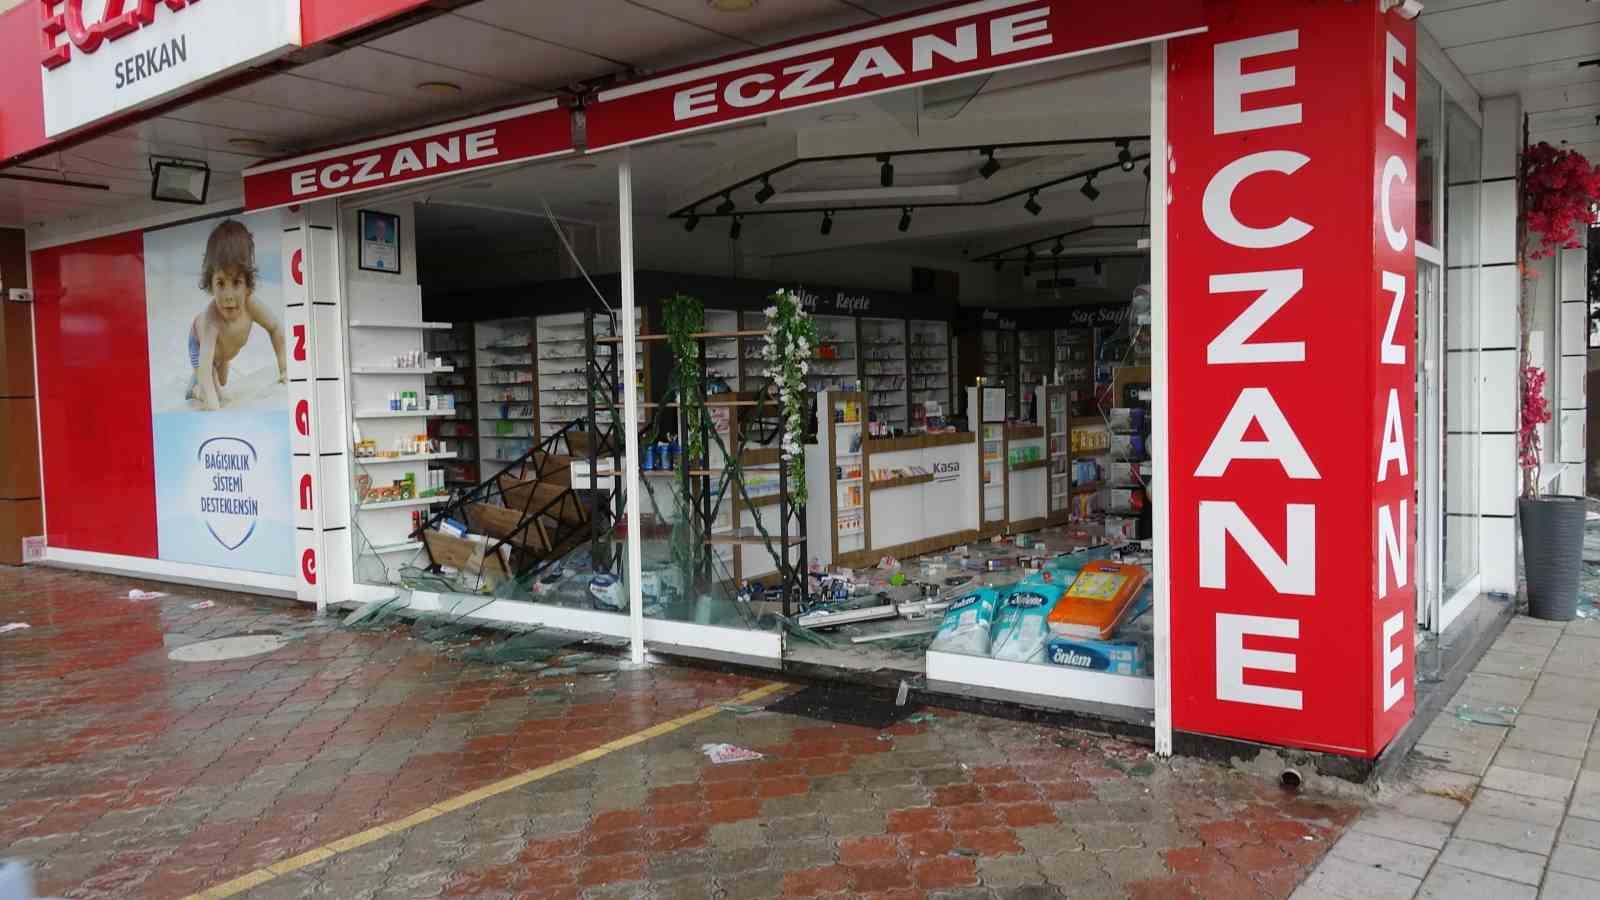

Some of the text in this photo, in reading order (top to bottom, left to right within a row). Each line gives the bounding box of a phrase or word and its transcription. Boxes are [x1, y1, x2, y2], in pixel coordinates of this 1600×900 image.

[115, 35, 187, 89] SERKAN
[673, 6, 1053, 121] ECZANE
[290, 129, 498, 196] ECZANE
[1193, 29, 1322, 711] ECZANE
[1377, 31, 1408, 712] ECZANE
[205, 451, 250, 472] BAĞIŞIKLIK
[933, 462, 960, 473] Kasa
[212, 472, 243, 493] SİSTEMİ
[201, 496, 259, 516] DESTEKLENSİN
[1054, 648, 1092, 667] önlem
